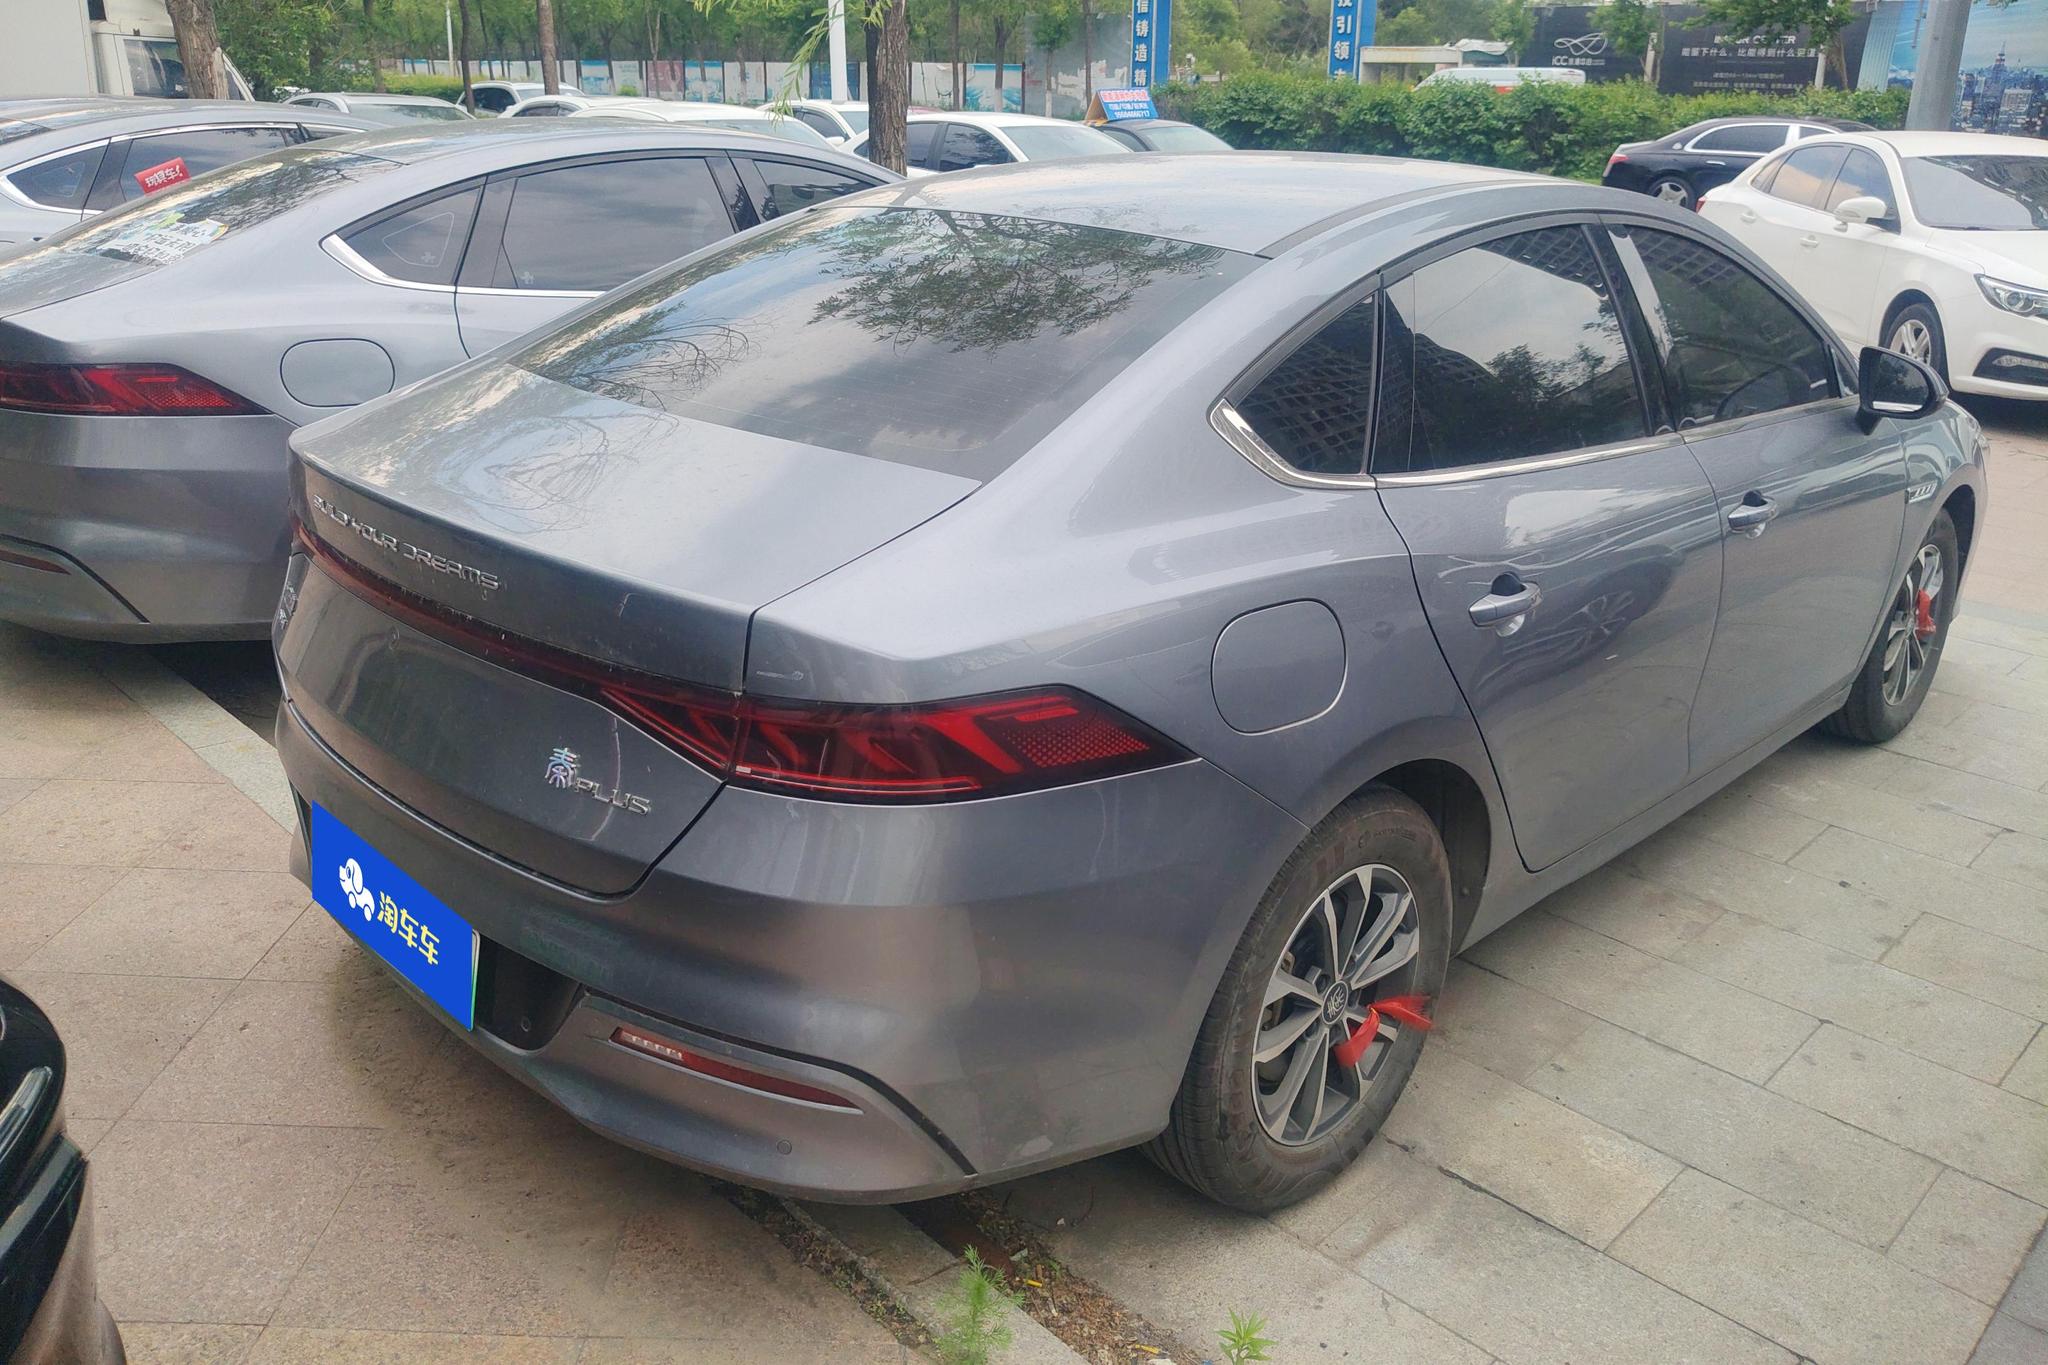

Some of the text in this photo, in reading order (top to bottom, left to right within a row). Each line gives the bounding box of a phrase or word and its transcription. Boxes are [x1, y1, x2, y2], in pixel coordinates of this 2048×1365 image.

[1753, 35, 1797, 45] CETER
[349, 518, 398, 553] YOUR
[403, 543, 499, 590] DREAMS
[573, 776, 652, 816] PLUS
